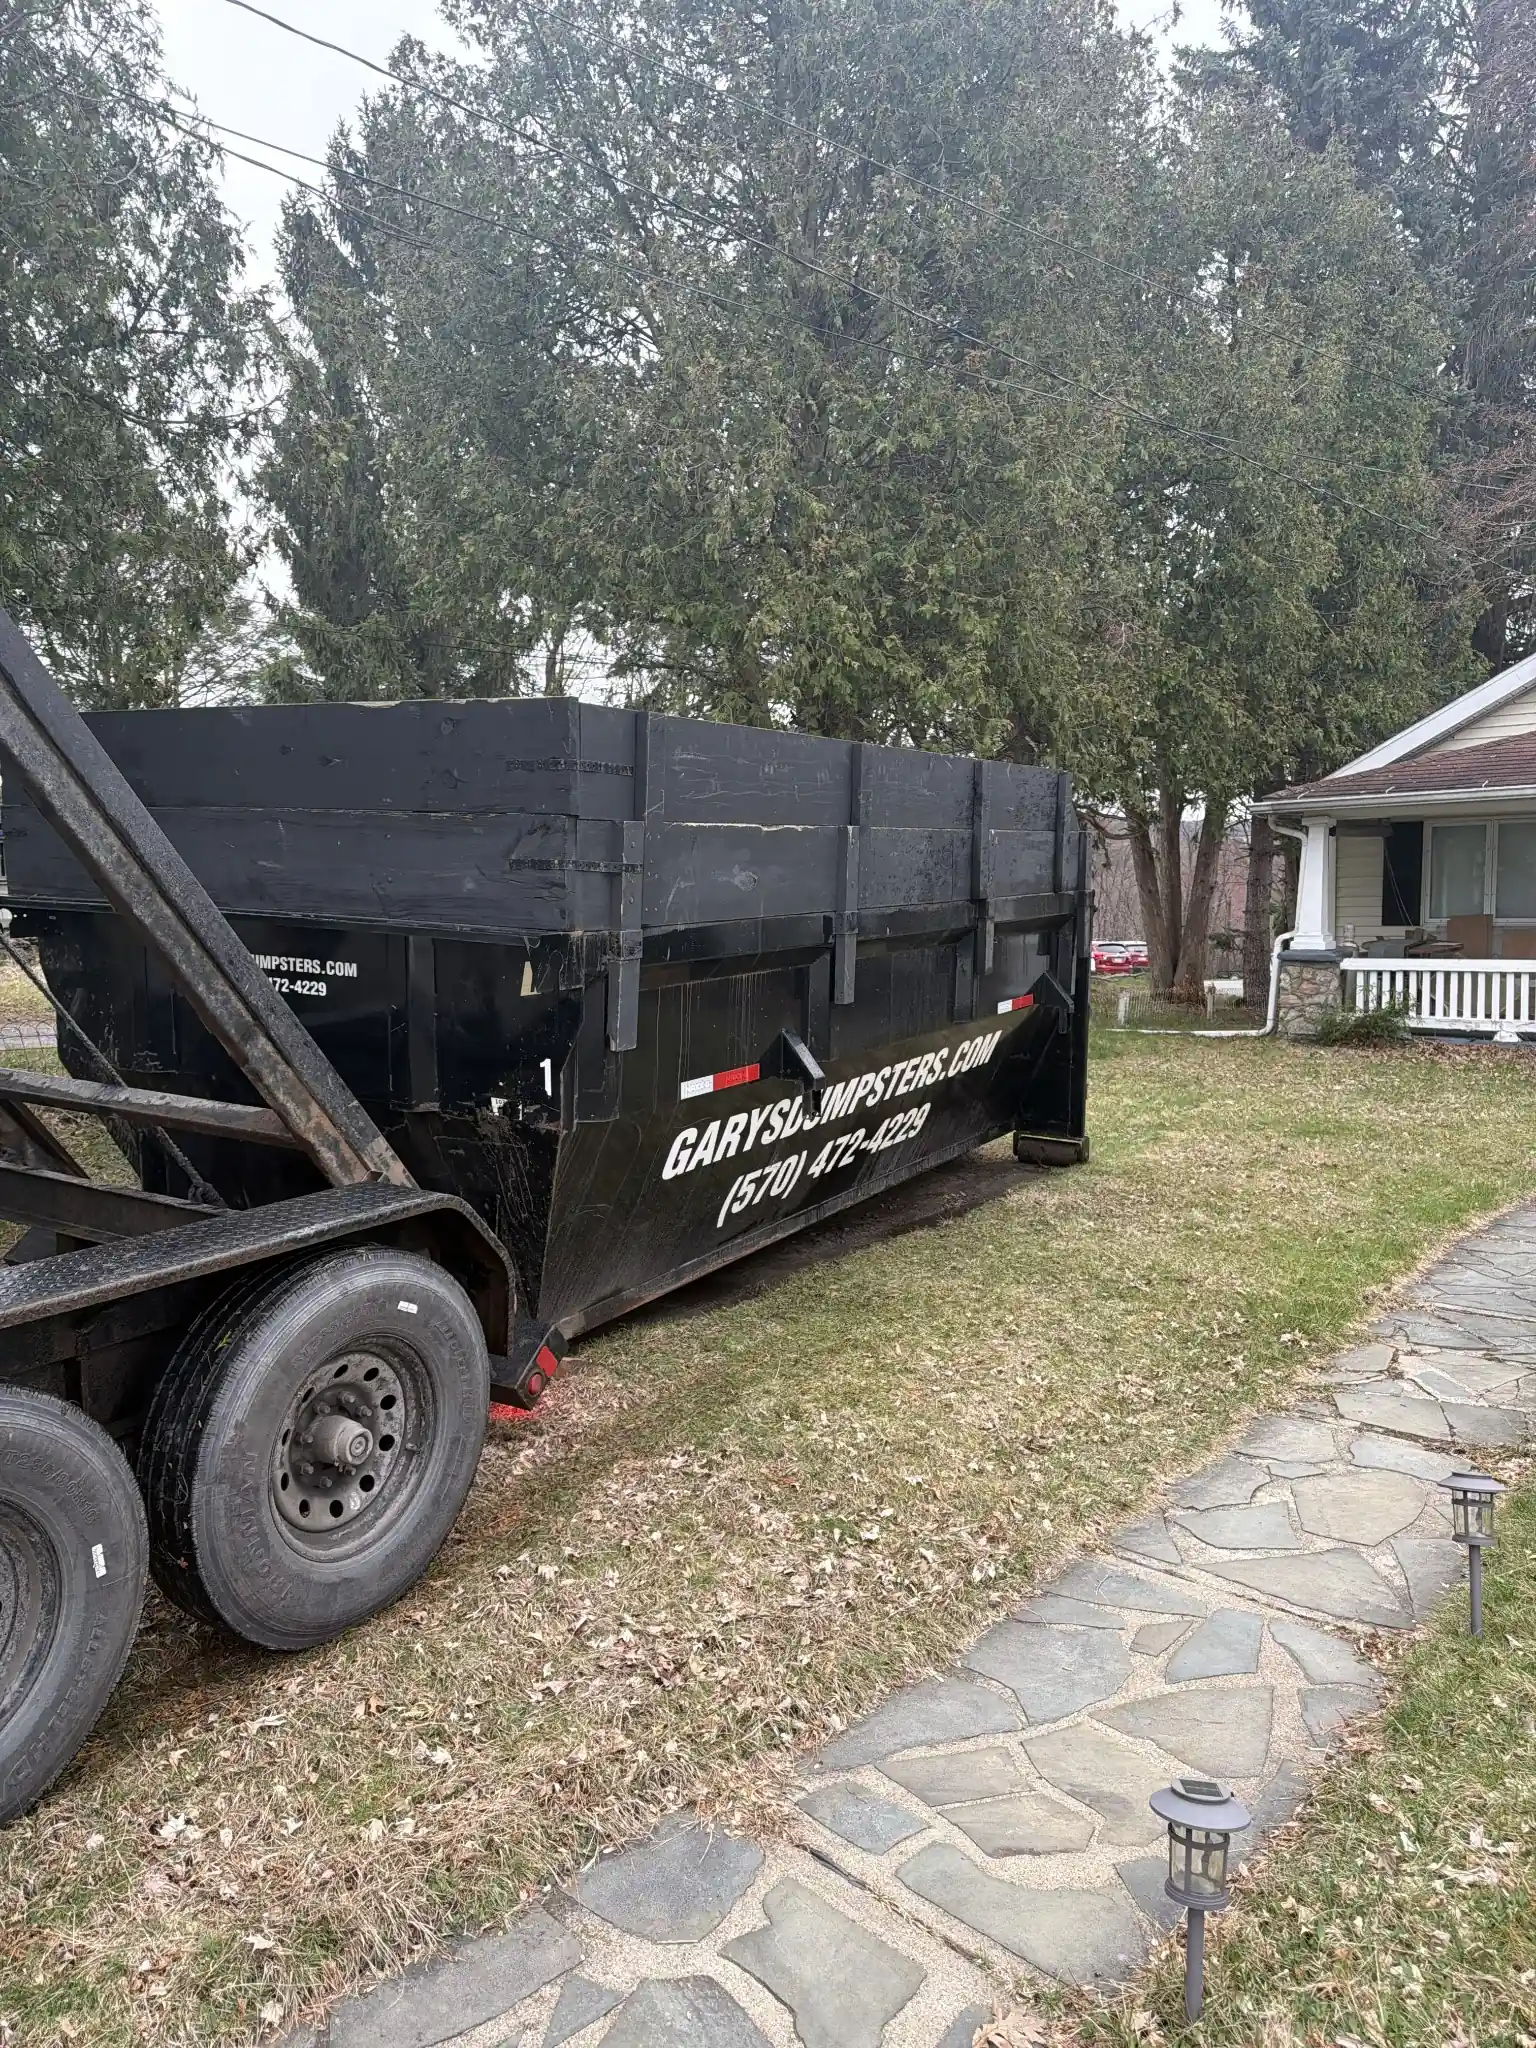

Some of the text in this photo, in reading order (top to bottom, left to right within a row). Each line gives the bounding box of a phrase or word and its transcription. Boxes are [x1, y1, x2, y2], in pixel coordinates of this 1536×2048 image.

[539, 1058, 552, 1097] 1
[716, 1102, 932, 1228] (570) 472-4229
[0, 1449, 100, 1527] T235/80R16
